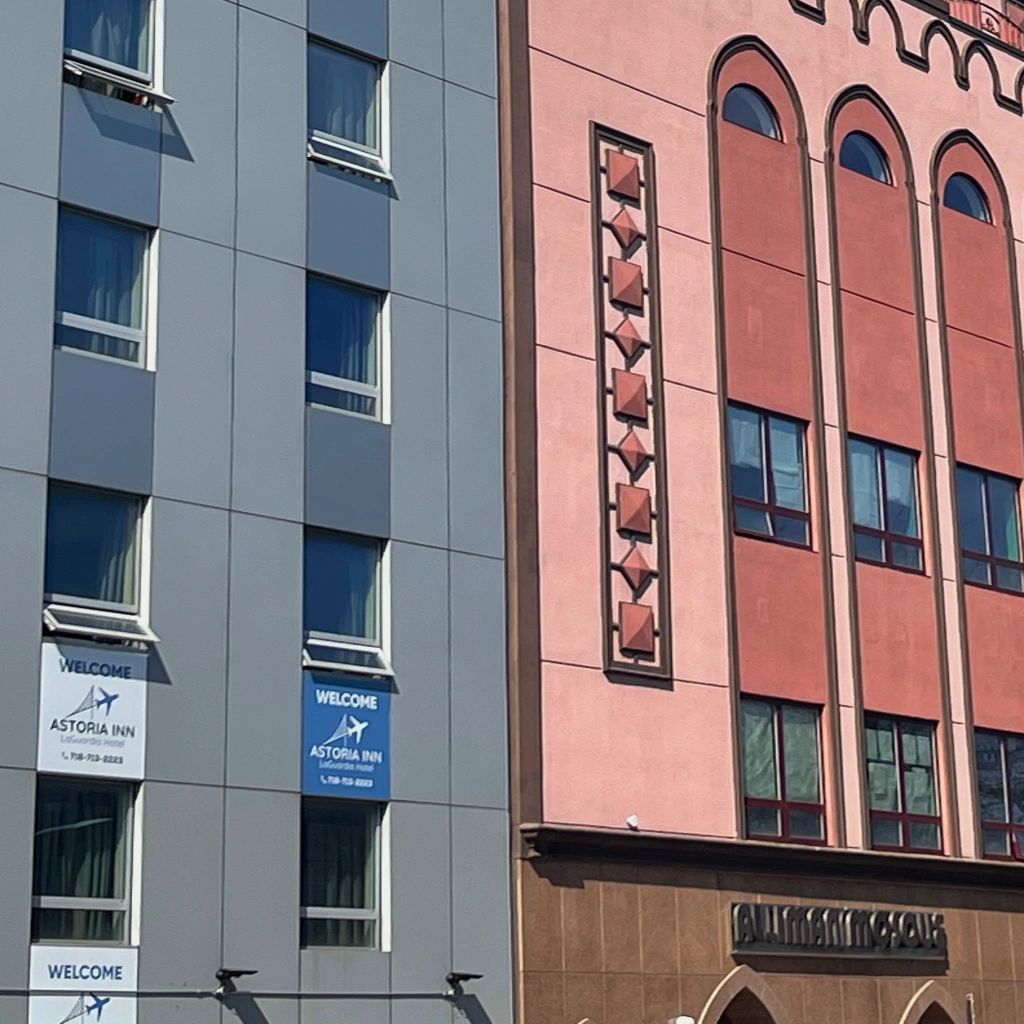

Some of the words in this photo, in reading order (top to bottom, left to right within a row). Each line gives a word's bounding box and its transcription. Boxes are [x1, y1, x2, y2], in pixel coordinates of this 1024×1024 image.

[60, 659, 132, 679] WELCOME
[315, 689, 378, 710] WELCOME
[50, 719, 108, 734] ASTORIA
[112, 724, 135, 738] INN
[310, 745, 360, 760] ASTORIA
[362, 750, 382, 763] INN
[47, 964, 123, 981] WELCOME
